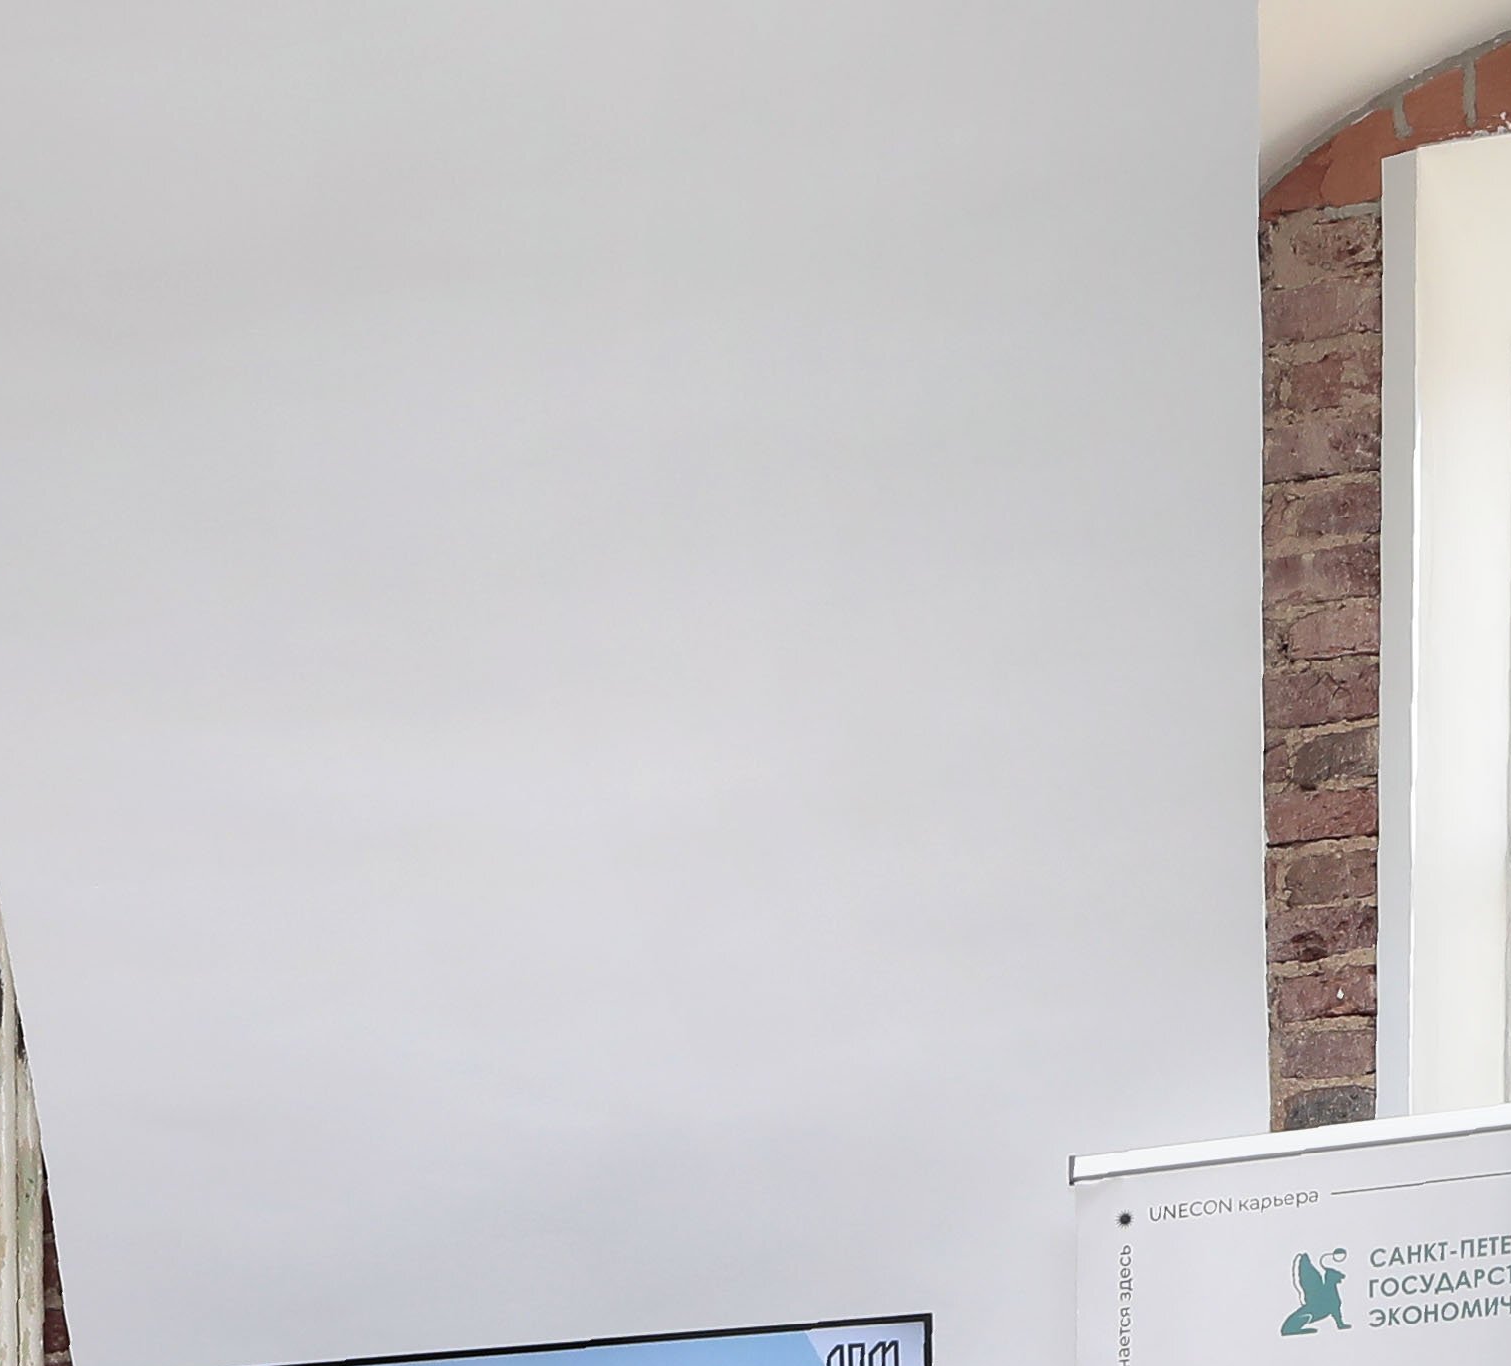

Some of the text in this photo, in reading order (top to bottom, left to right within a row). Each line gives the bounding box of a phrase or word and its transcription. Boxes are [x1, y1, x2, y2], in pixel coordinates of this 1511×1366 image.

[1149, 1190, 1319, 1222] UNECON карьера
[1119, 1245, 1133, 1301] здесь
